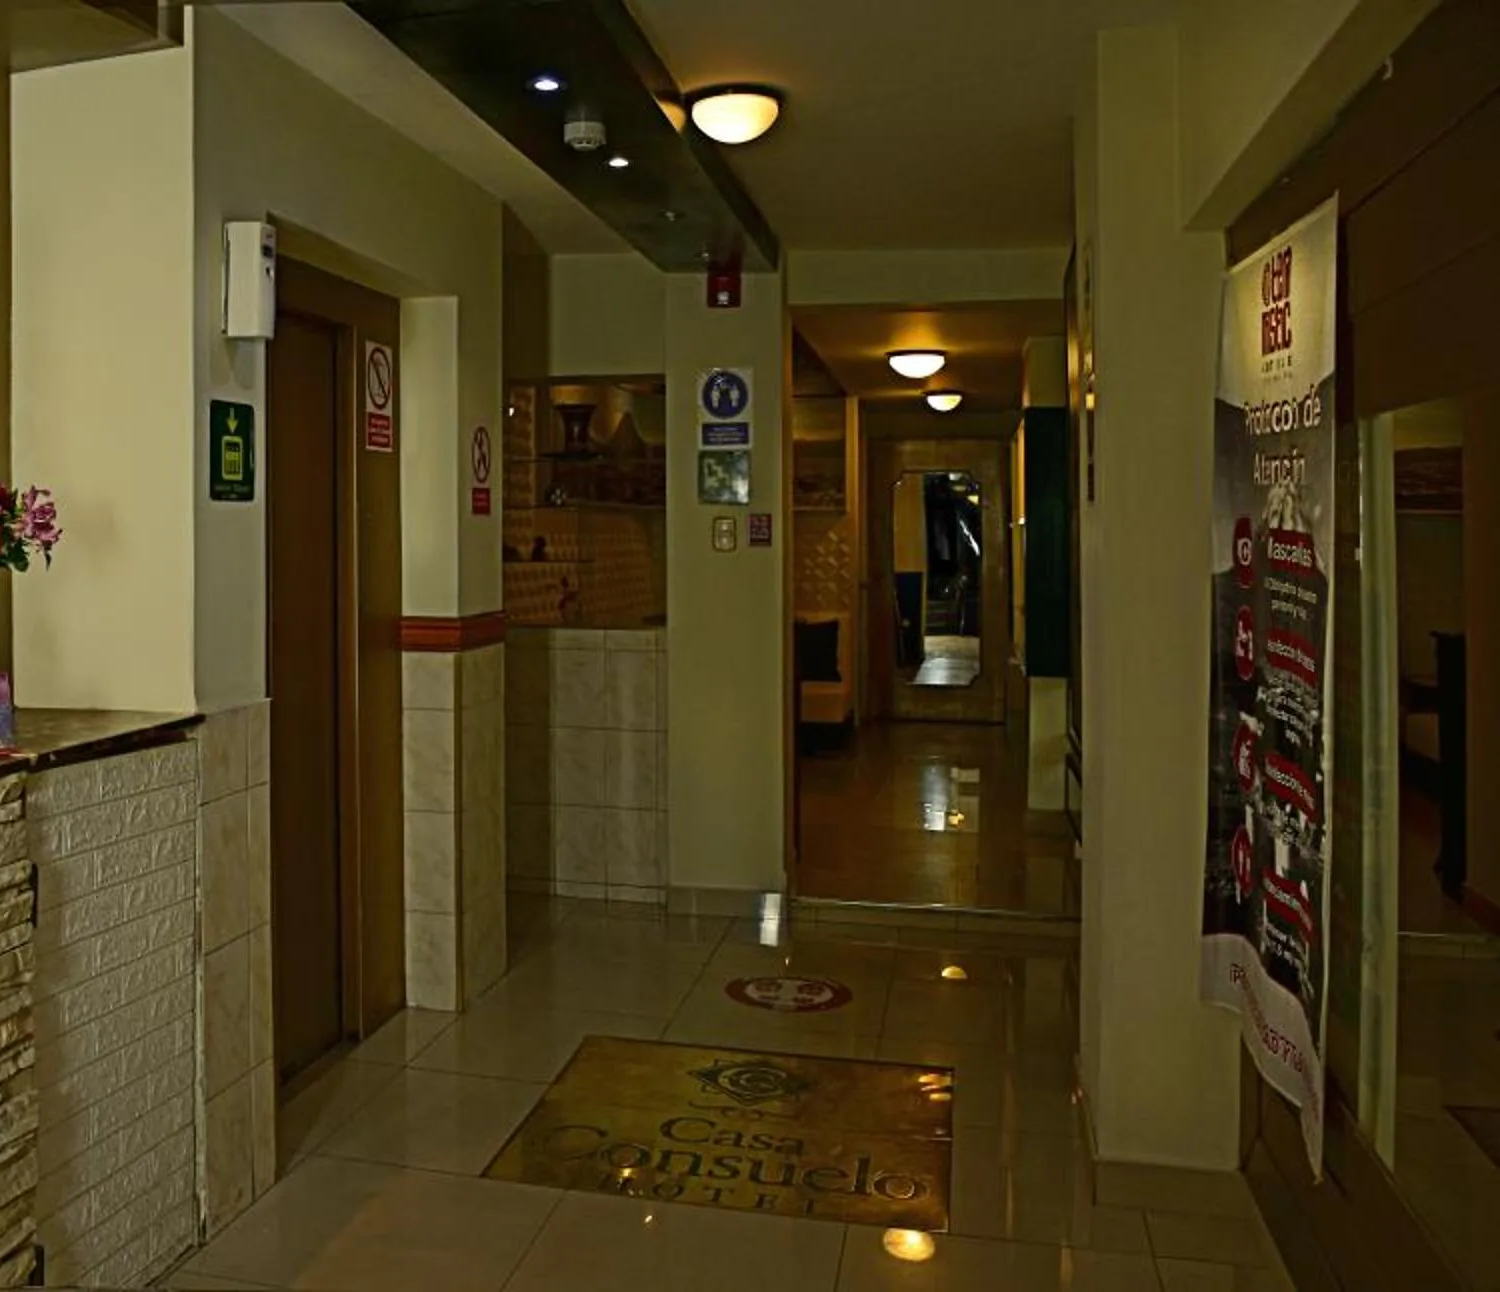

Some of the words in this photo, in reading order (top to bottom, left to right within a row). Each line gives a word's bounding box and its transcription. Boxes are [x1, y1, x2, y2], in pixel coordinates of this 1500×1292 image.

[1303, 386, 1322, 428] de
[660, 1116, 805, 1154] Casa
[547, 1125, 927, 1200] Consuelo
